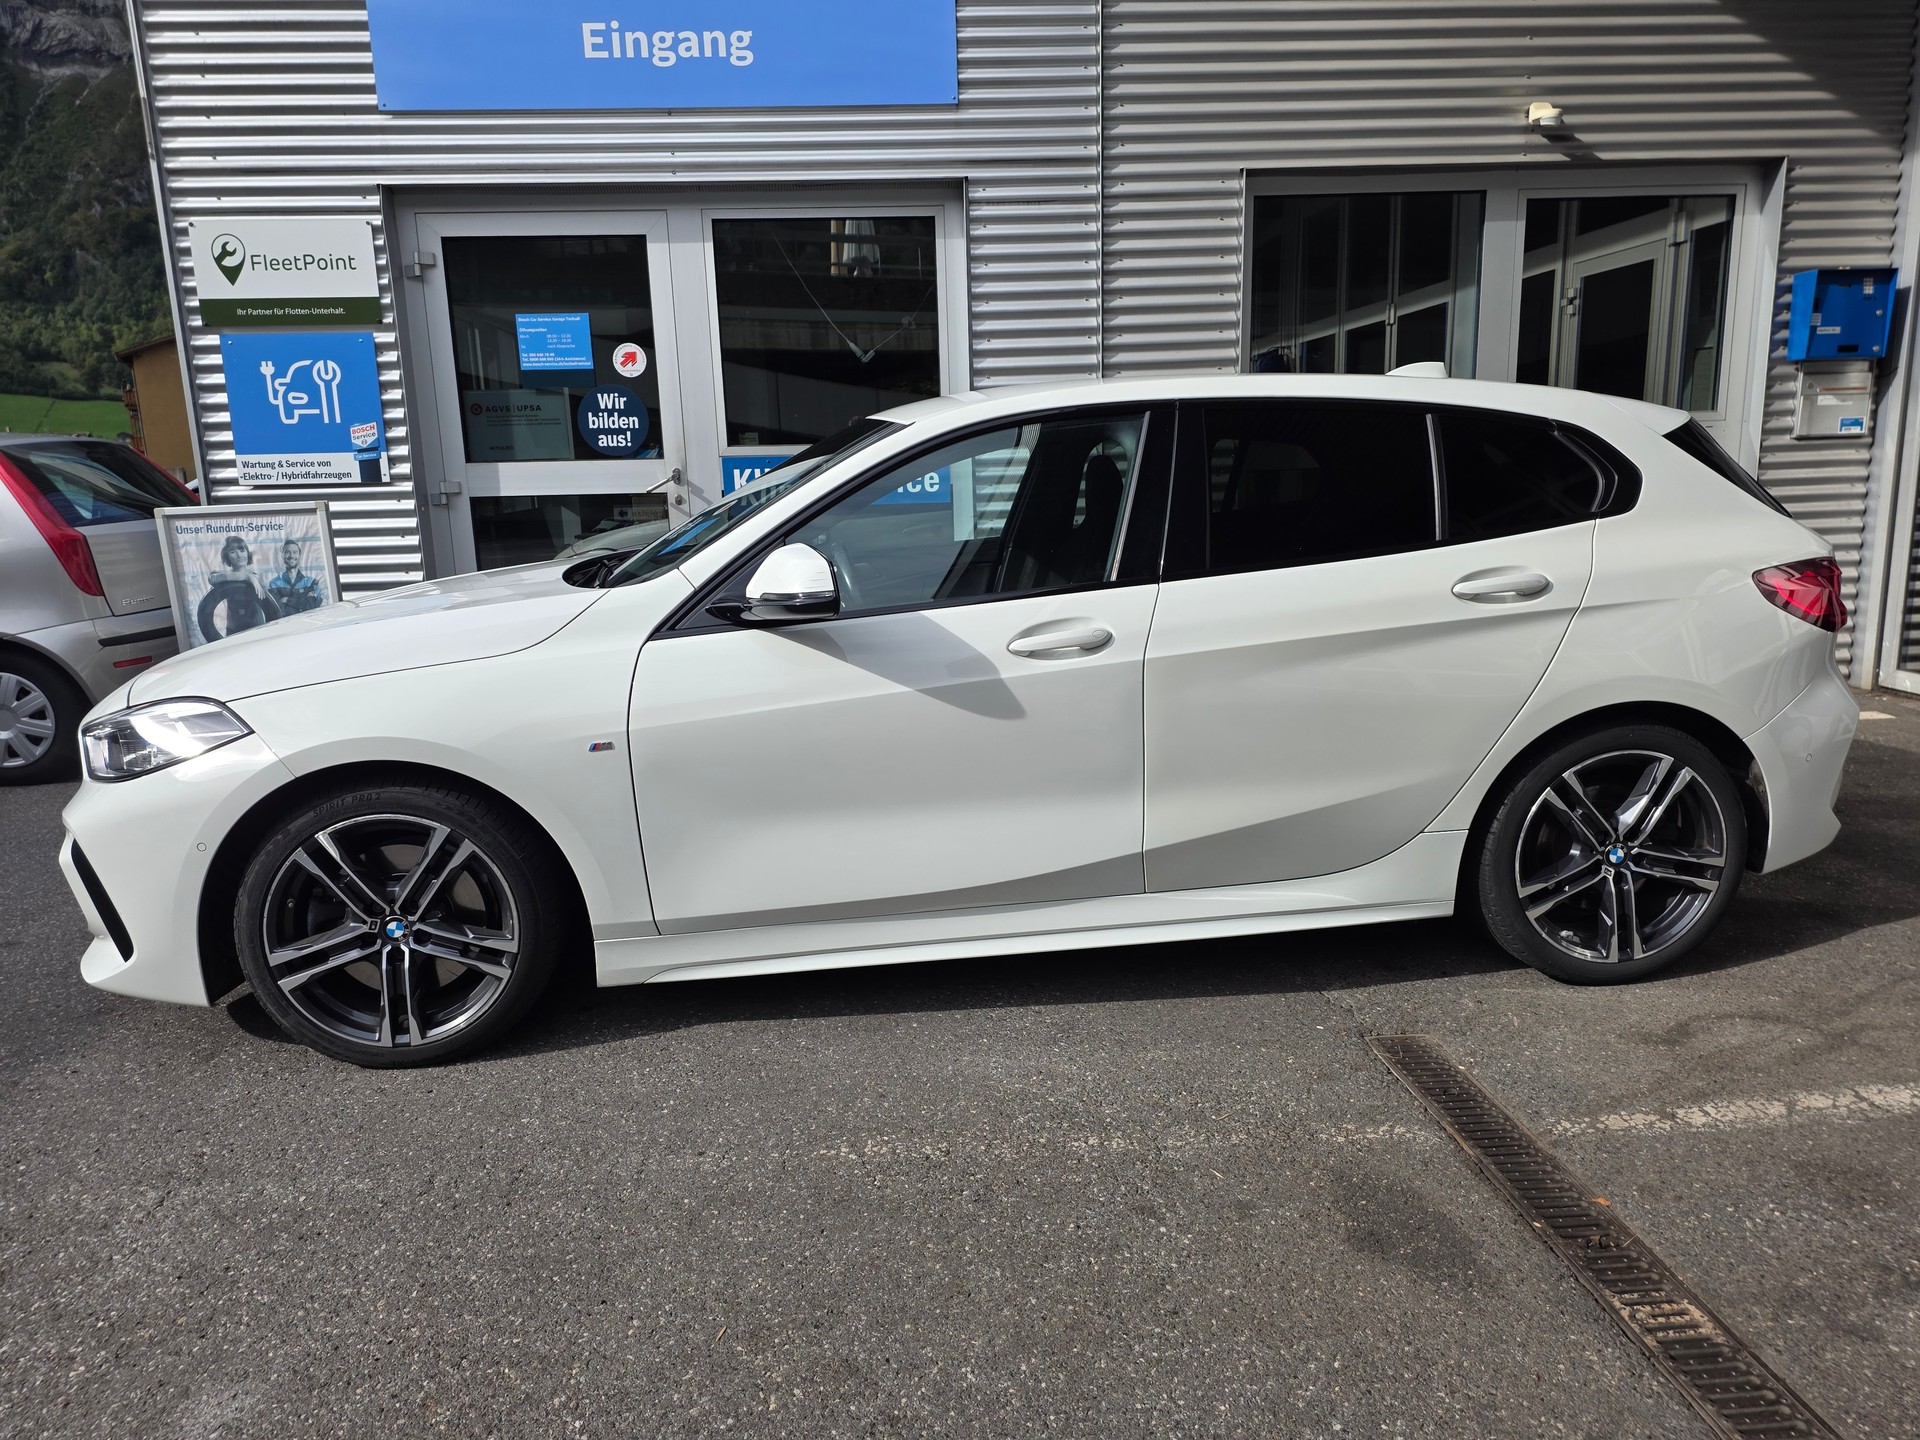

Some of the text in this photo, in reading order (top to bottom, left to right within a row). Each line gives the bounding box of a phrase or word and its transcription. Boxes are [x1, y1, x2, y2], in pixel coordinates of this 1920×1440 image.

[582, 20, 754, 67] Eingang
[250, 253, 357, 271] FleetPoint
[236, 307, 346, 316] Ihr Partner für Flotten-Unterhalt.
[597, 393, 627, 409] Wir
[485, 404, 542, 413] AGVS UPSA
[588, 412, 639, 429] bilden
[352, 424, 376, 435] BOSCH
[352, 431, 376, 441] Service
[598, 431, 632, 448] aus!
[241, 461, 276, 470] Wartung
[278, 460, 284, 468] &
[281, 471, 352, 481] Hybridfahrzeugen
[175, 521, 284, 534] Unser Rundum-Service
[313, 798, 346, 818] SPIRIT
